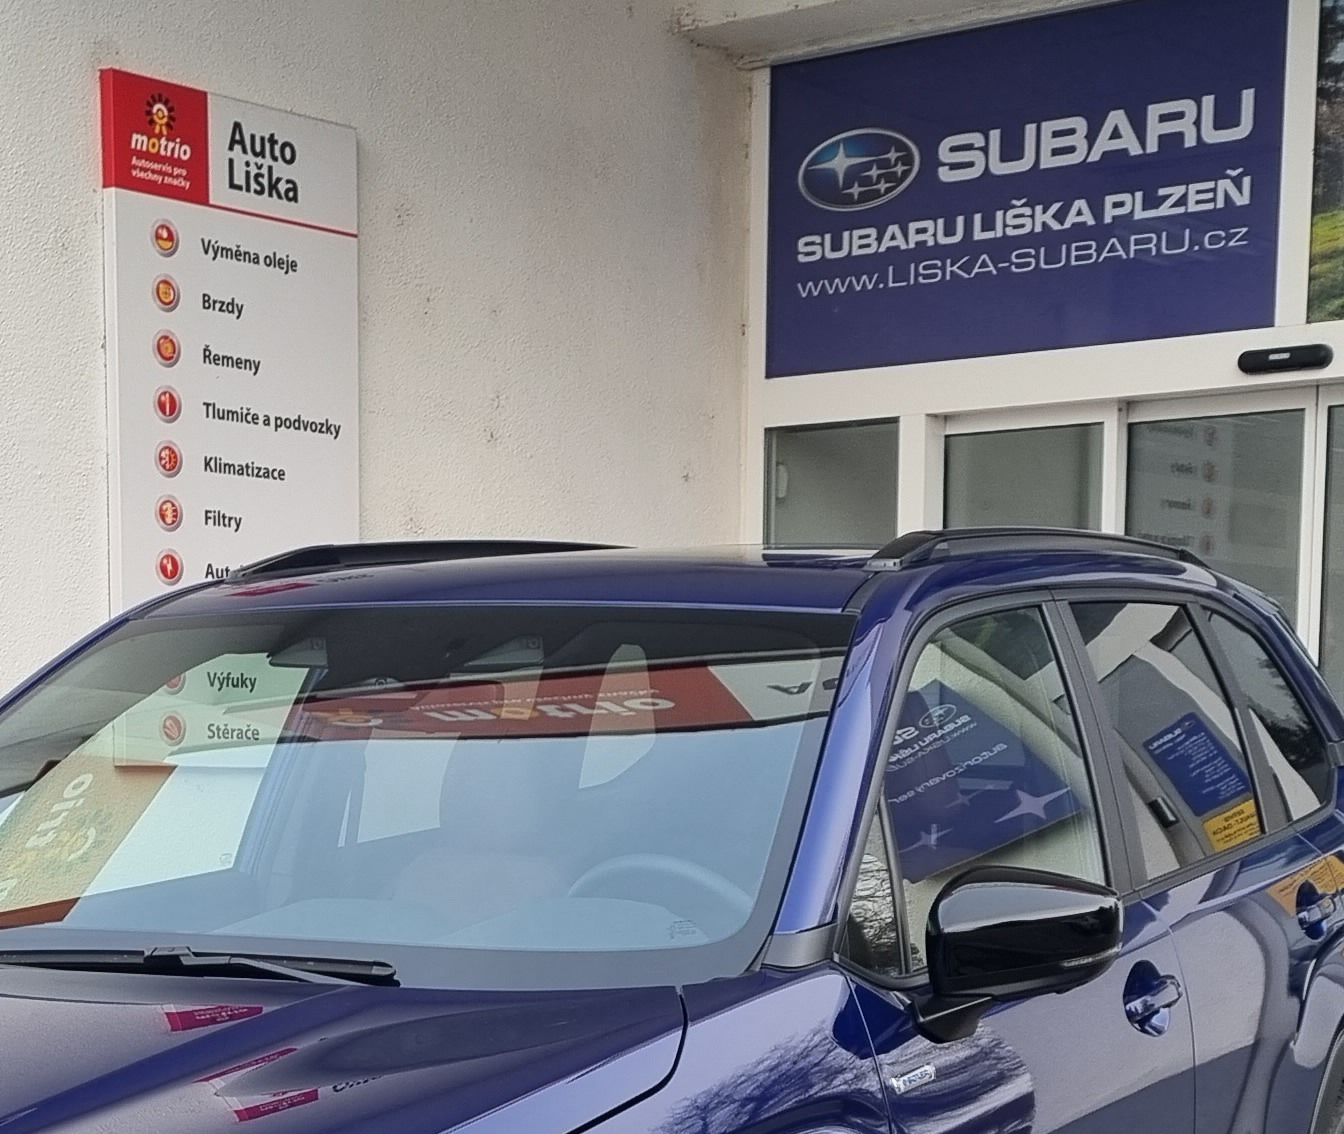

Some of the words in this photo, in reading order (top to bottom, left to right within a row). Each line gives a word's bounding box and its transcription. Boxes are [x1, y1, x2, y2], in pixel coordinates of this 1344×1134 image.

[131, 133, 191, 161] motrio
[228, 121, 297, 165] Auto
[937, 88, 1255, 183] SUBARU
[228, 158, 299, 203] Liška
[797, 215, 965, 263] SUBARU
[973, 198, 1096, 241] LIŠKA
[1104, 167, 1252, 225] PLZEŇ
[201, 237, 260, 265] Výměna
[264, 251, 298, 275] oleje
[797, 227, 1249, 298] www.LISKA-SUBARU.cz
[202, 293, 244, 320] Brzdy
[203, 345, 261, 376] Řemeny
[203, 402, 259, 425] Tlumiče
[263, 415, 271, 427] a
[274, 415, 342, 440] podvozky
[204, 456, 286, 481] Klimatizace
[205, 510, 242, 532] Filtry
[205, 563, 232, 580] Aut
[207, 671, 257, 693] Výfuky
[207, 723, 260, 741] Stěrače
